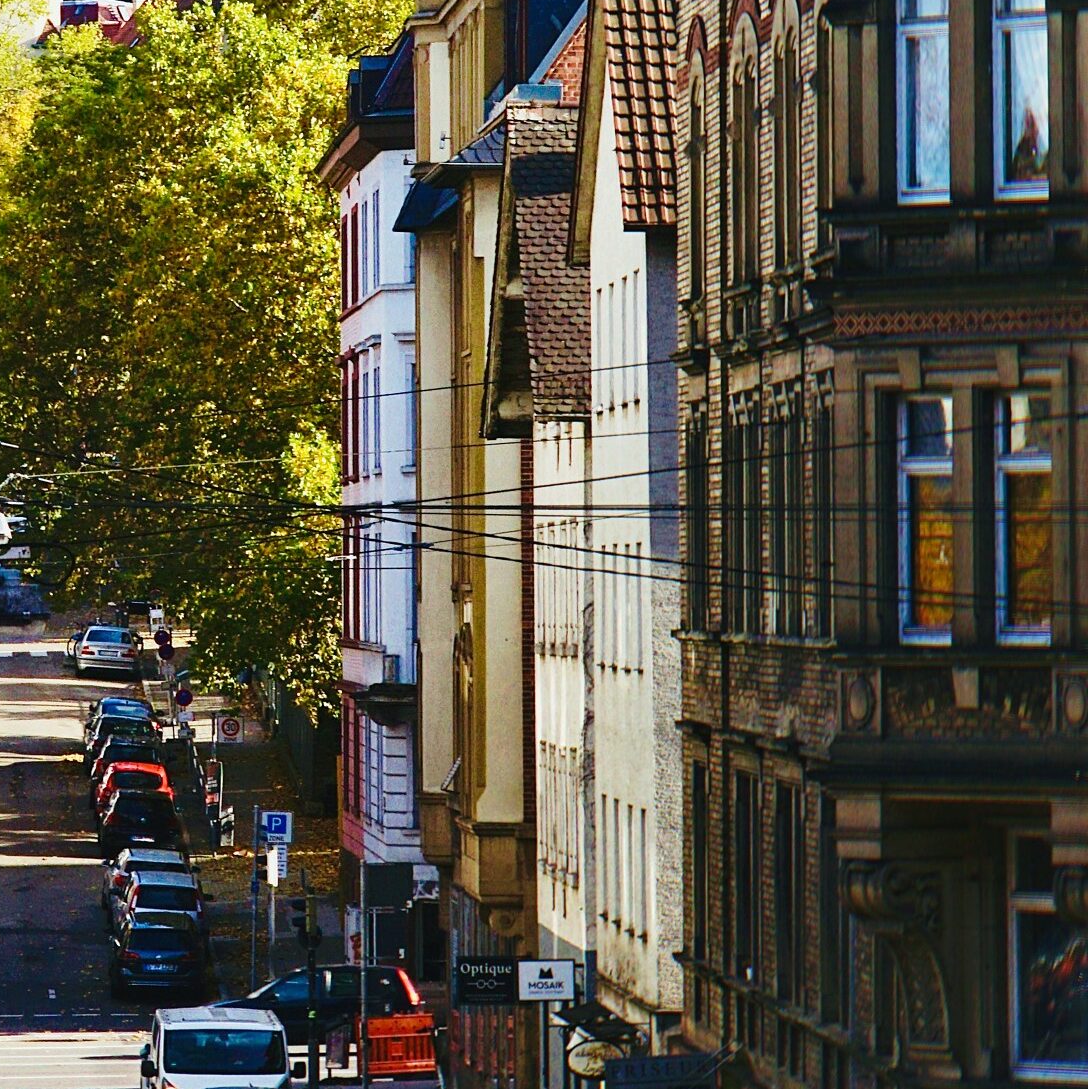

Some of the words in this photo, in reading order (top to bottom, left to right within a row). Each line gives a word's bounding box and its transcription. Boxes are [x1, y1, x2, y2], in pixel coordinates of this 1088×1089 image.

[226, 722, 236, 732] 30
[272, 817, 282, 831] P
[460, 963, 512, 977] Optique
[528, 981, 564, 990] MOSAIK
